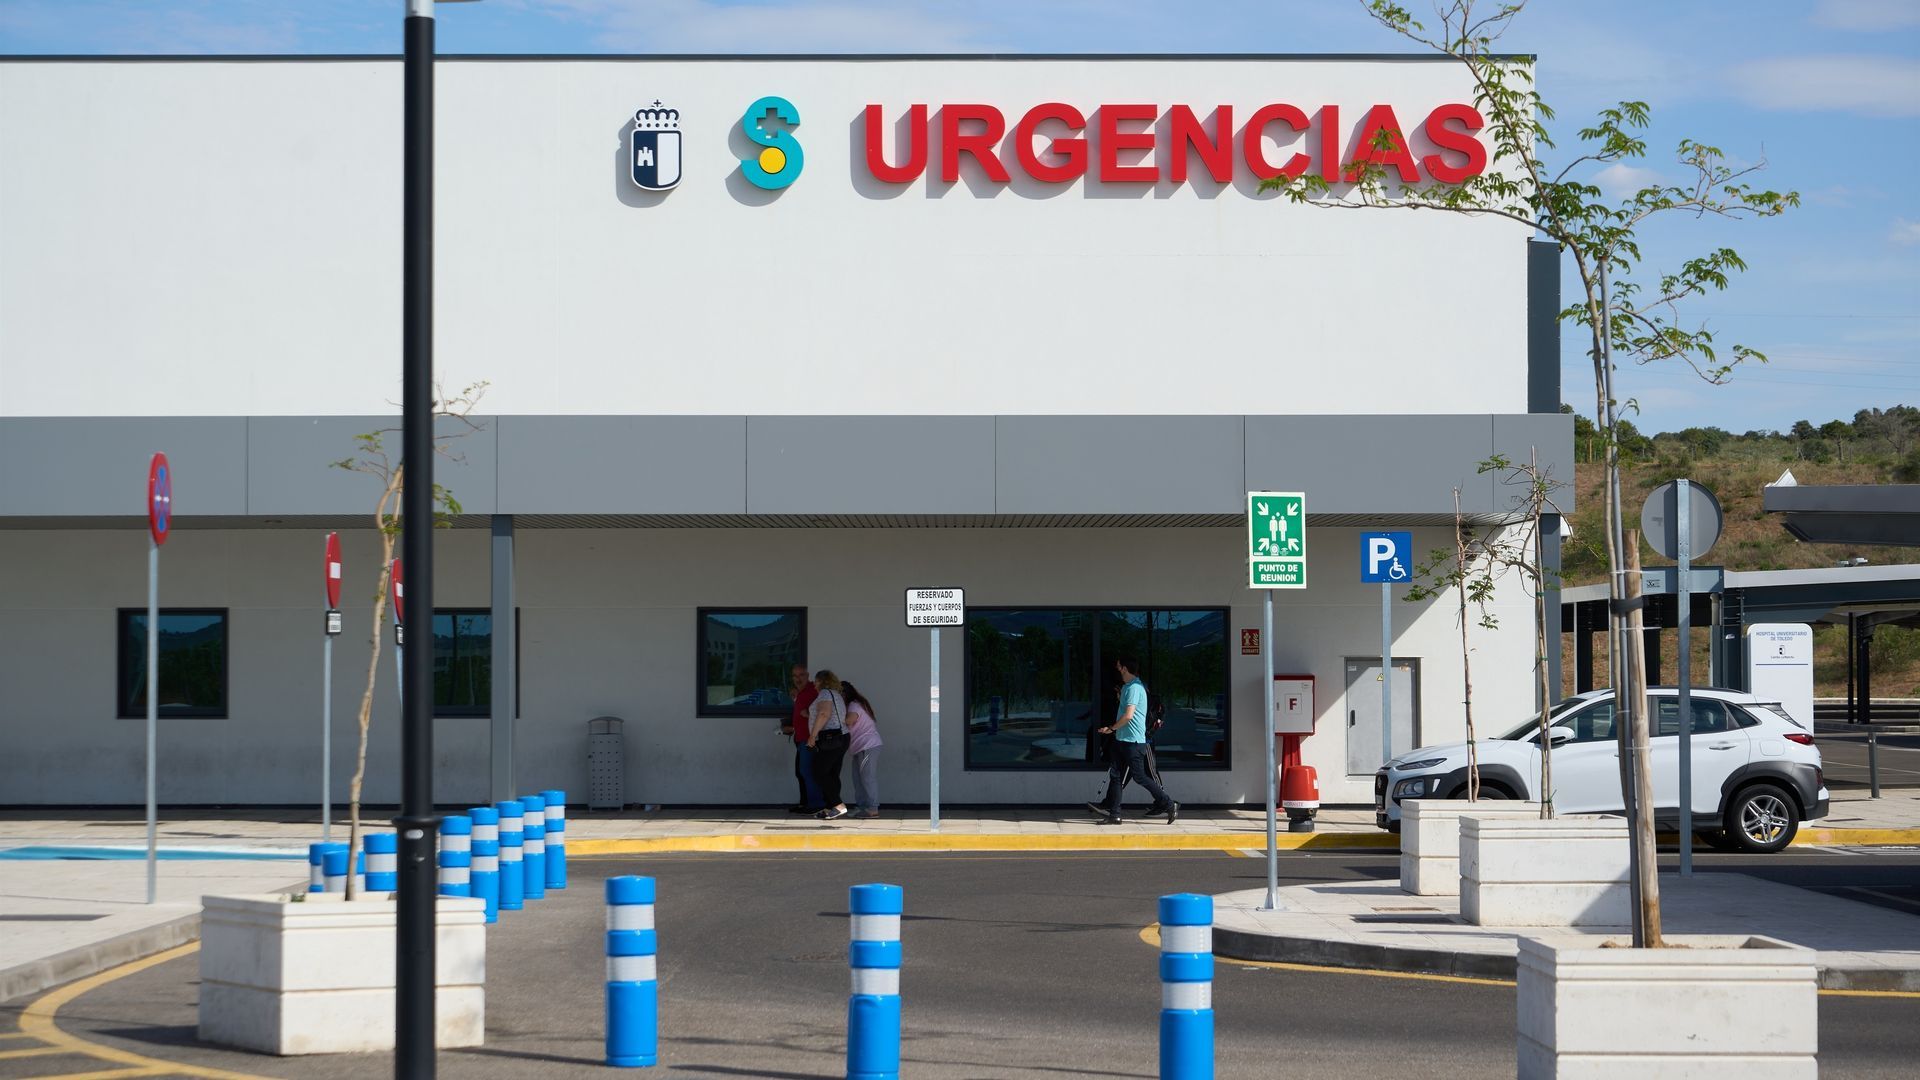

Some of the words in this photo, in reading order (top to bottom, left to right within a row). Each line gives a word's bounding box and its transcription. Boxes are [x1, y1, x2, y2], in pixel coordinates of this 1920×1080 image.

[865, 103, 1488, 184] URGENCIAS
[1369, 538, 1396, 575] P
[1258, 564, 1286, 572] PUNTO
[1287, 564, 1298, 572] DE
[1260, 574, 1297, 582] REUNION
[1289, 698, 1298, 710] F
